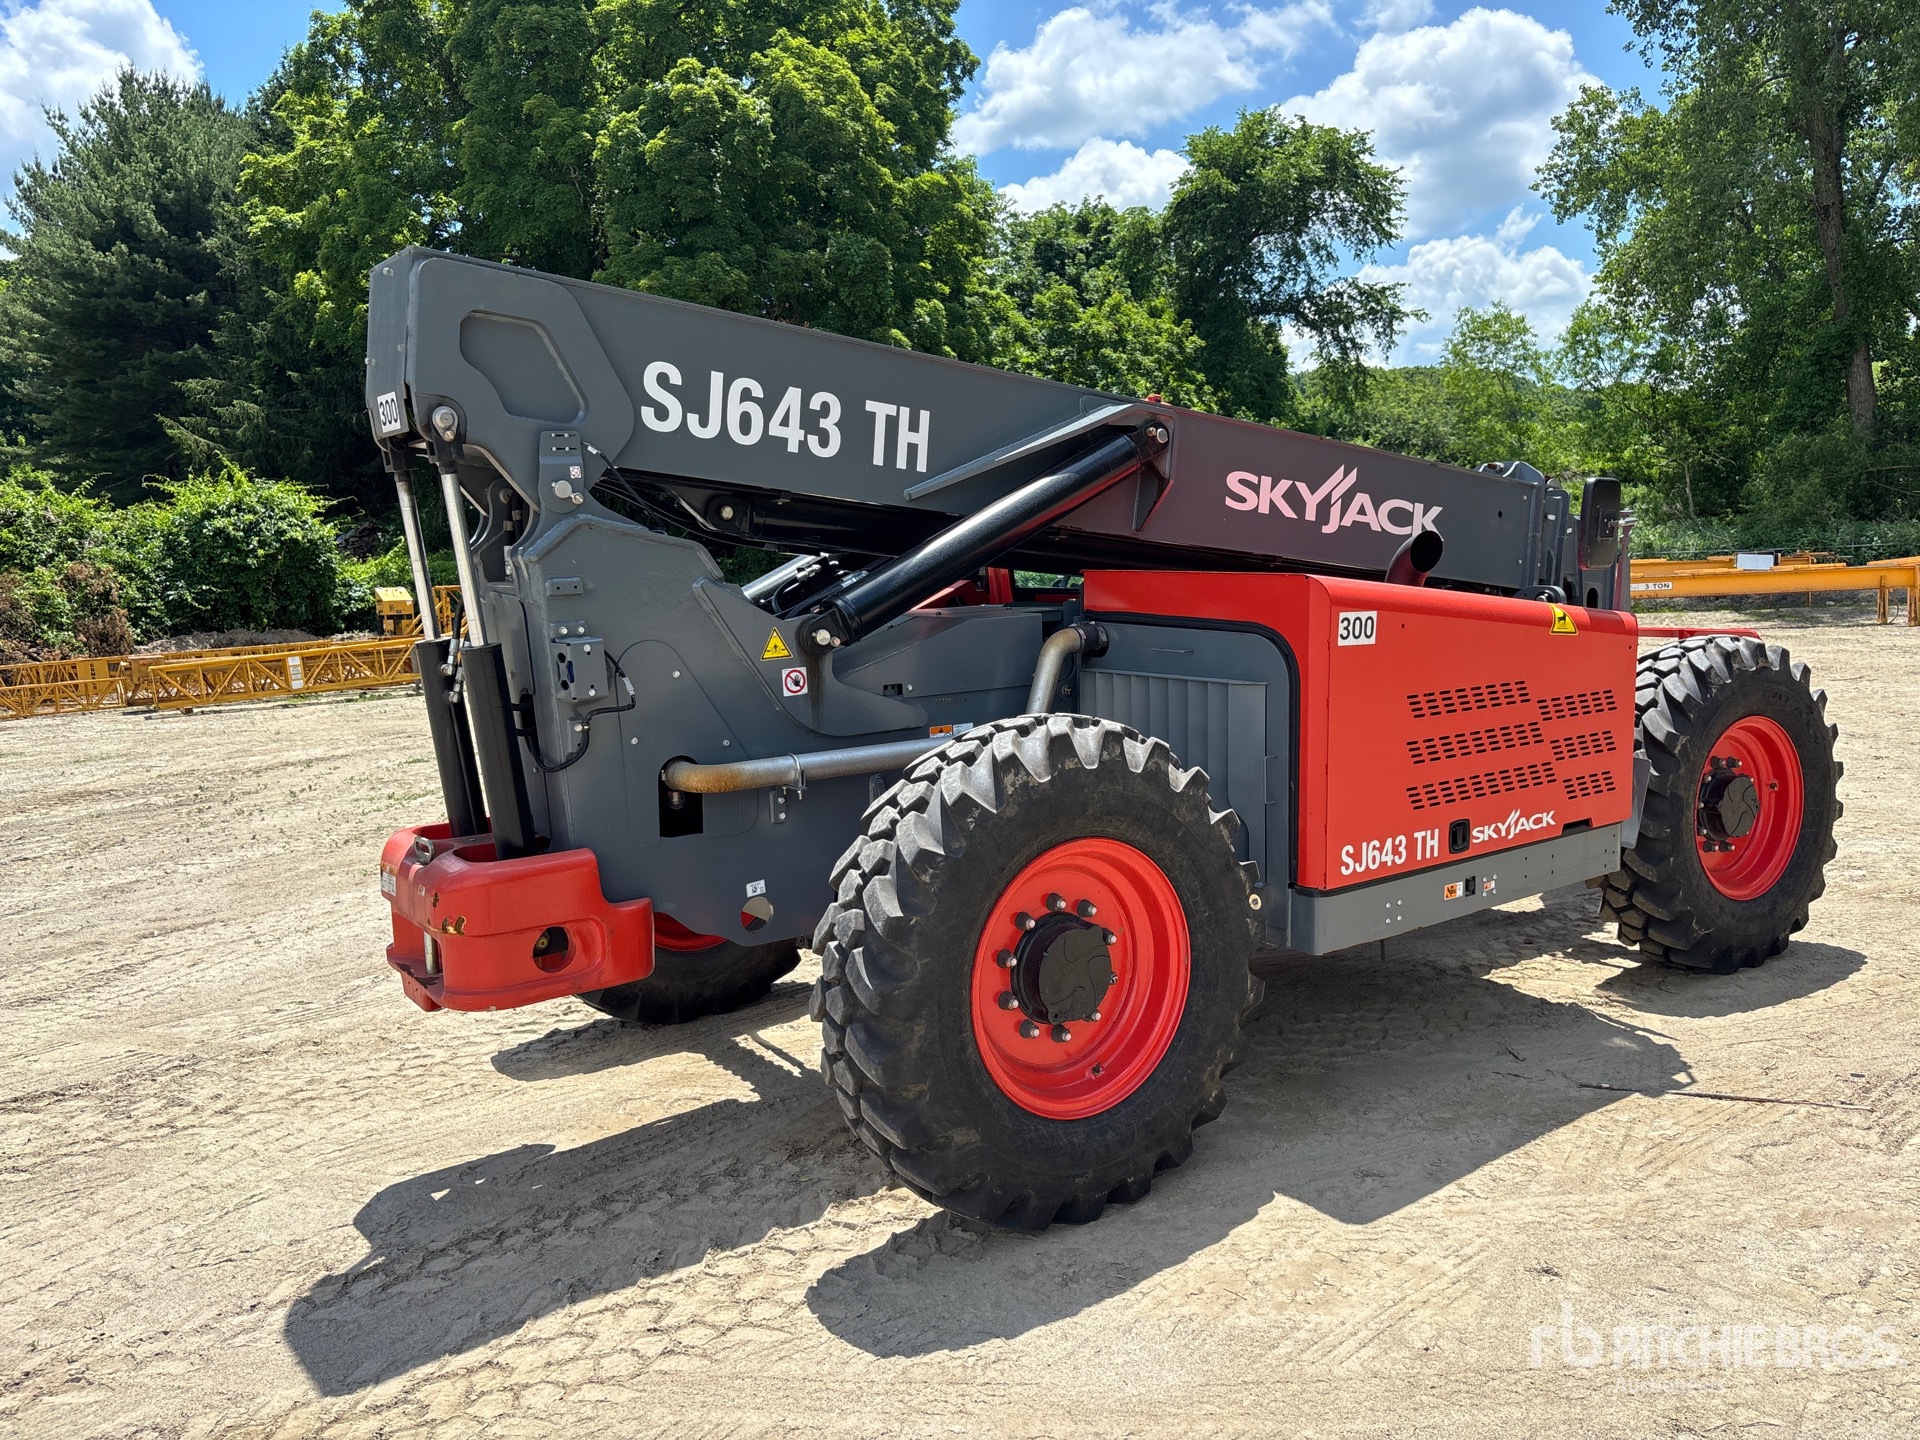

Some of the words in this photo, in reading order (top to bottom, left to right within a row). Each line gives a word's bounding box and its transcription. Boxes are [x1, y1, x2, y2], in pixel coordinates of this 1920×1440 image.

[380, 398, 399, 426] 300
[641, 361, 842, 458] SJ643
[865, 400, 931, 473] TH
[1225, 463, 1445, 542] SKYJACK
[1653, 582, 1670, 590] TON
[1340, 615, 1375, 640] 300
[1472, 808, 1556, 844] SKYJACK
[1340, 834, 1407, 876] SJ643
[1413, 828, 1439, 861] TH
